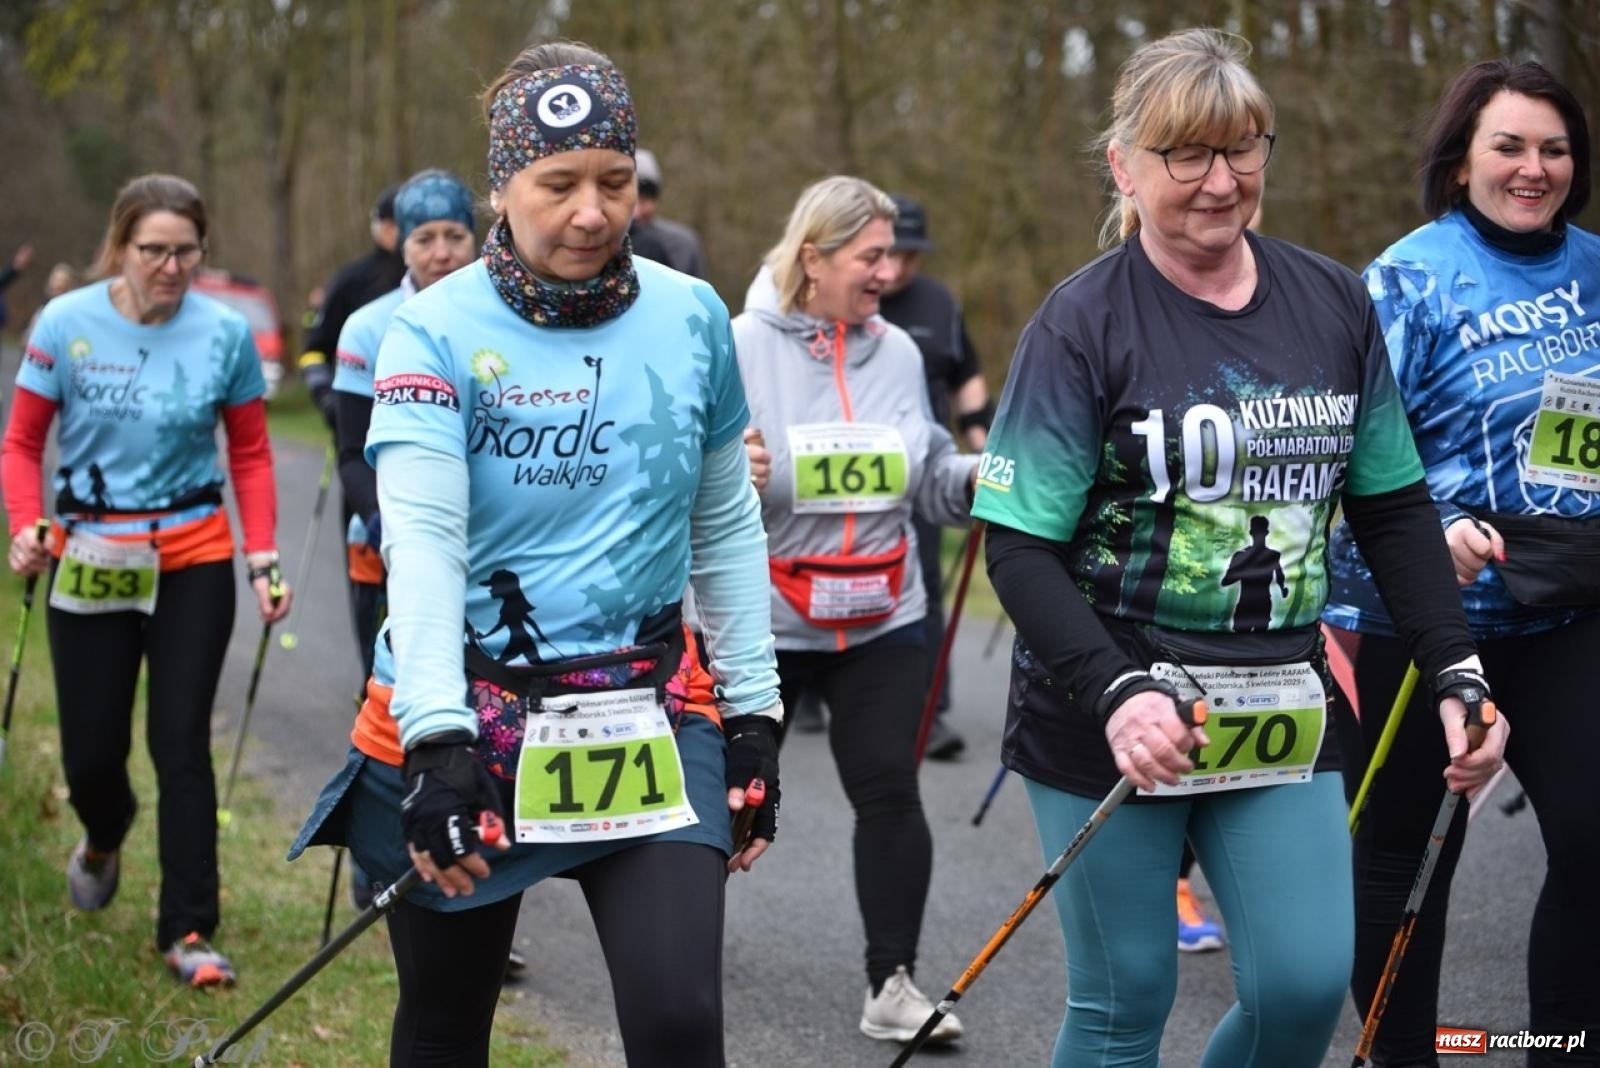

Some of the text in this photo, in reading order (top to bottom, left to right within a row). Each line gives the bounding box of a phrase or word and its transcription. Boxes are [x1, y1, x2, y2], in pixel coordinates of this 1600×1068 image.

[1459, 280, 1586, 354] MORSY
[1131, 403, 1236, 504] 10
[1247, 433, 1337, 459] PÓŁMARATON
[513, 463, 608, 490] Walking
[813, 455, 891, 495] 161
[68, 562, 140, 600] 153
[544, 743, 666, 813] 171
